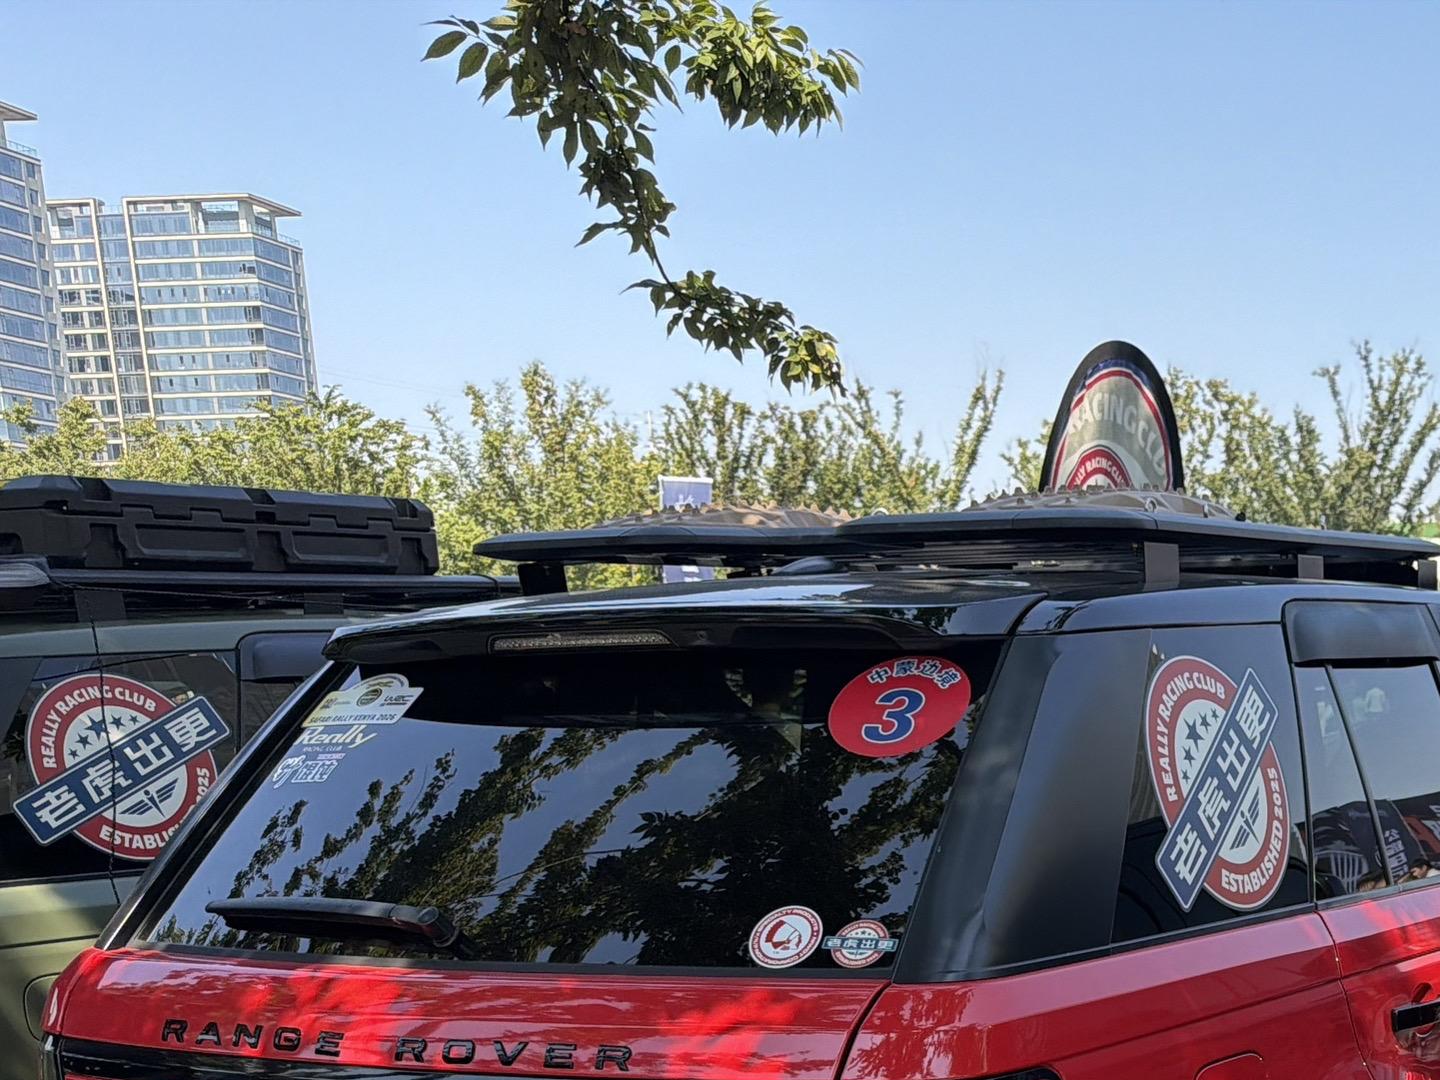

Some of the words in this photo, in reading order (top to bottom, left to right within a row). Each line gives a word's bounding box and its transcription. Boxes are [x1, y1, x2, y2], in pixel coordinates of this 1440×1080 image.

[867, 659, 961, 689] 中蒙边境
[1158, 672, 1194, 717] RACING
[1192, 672, 1226, 700] CLUB
[40, 708, 62, 769] REALLY
[56, 685, 112, 713] RACING
[114, 686, 157, 712] CLUB
[861, 687, 926, 744] 3
[1156, 720, 1179, 802] REALLY
[1221, 821, 1283, 894] ESTABLISHED
[1267, 767, 1282, 820] 2025
[160, 1018, 345, 1057] RANGE
[394, 1036, 633, 1072] ROVER
